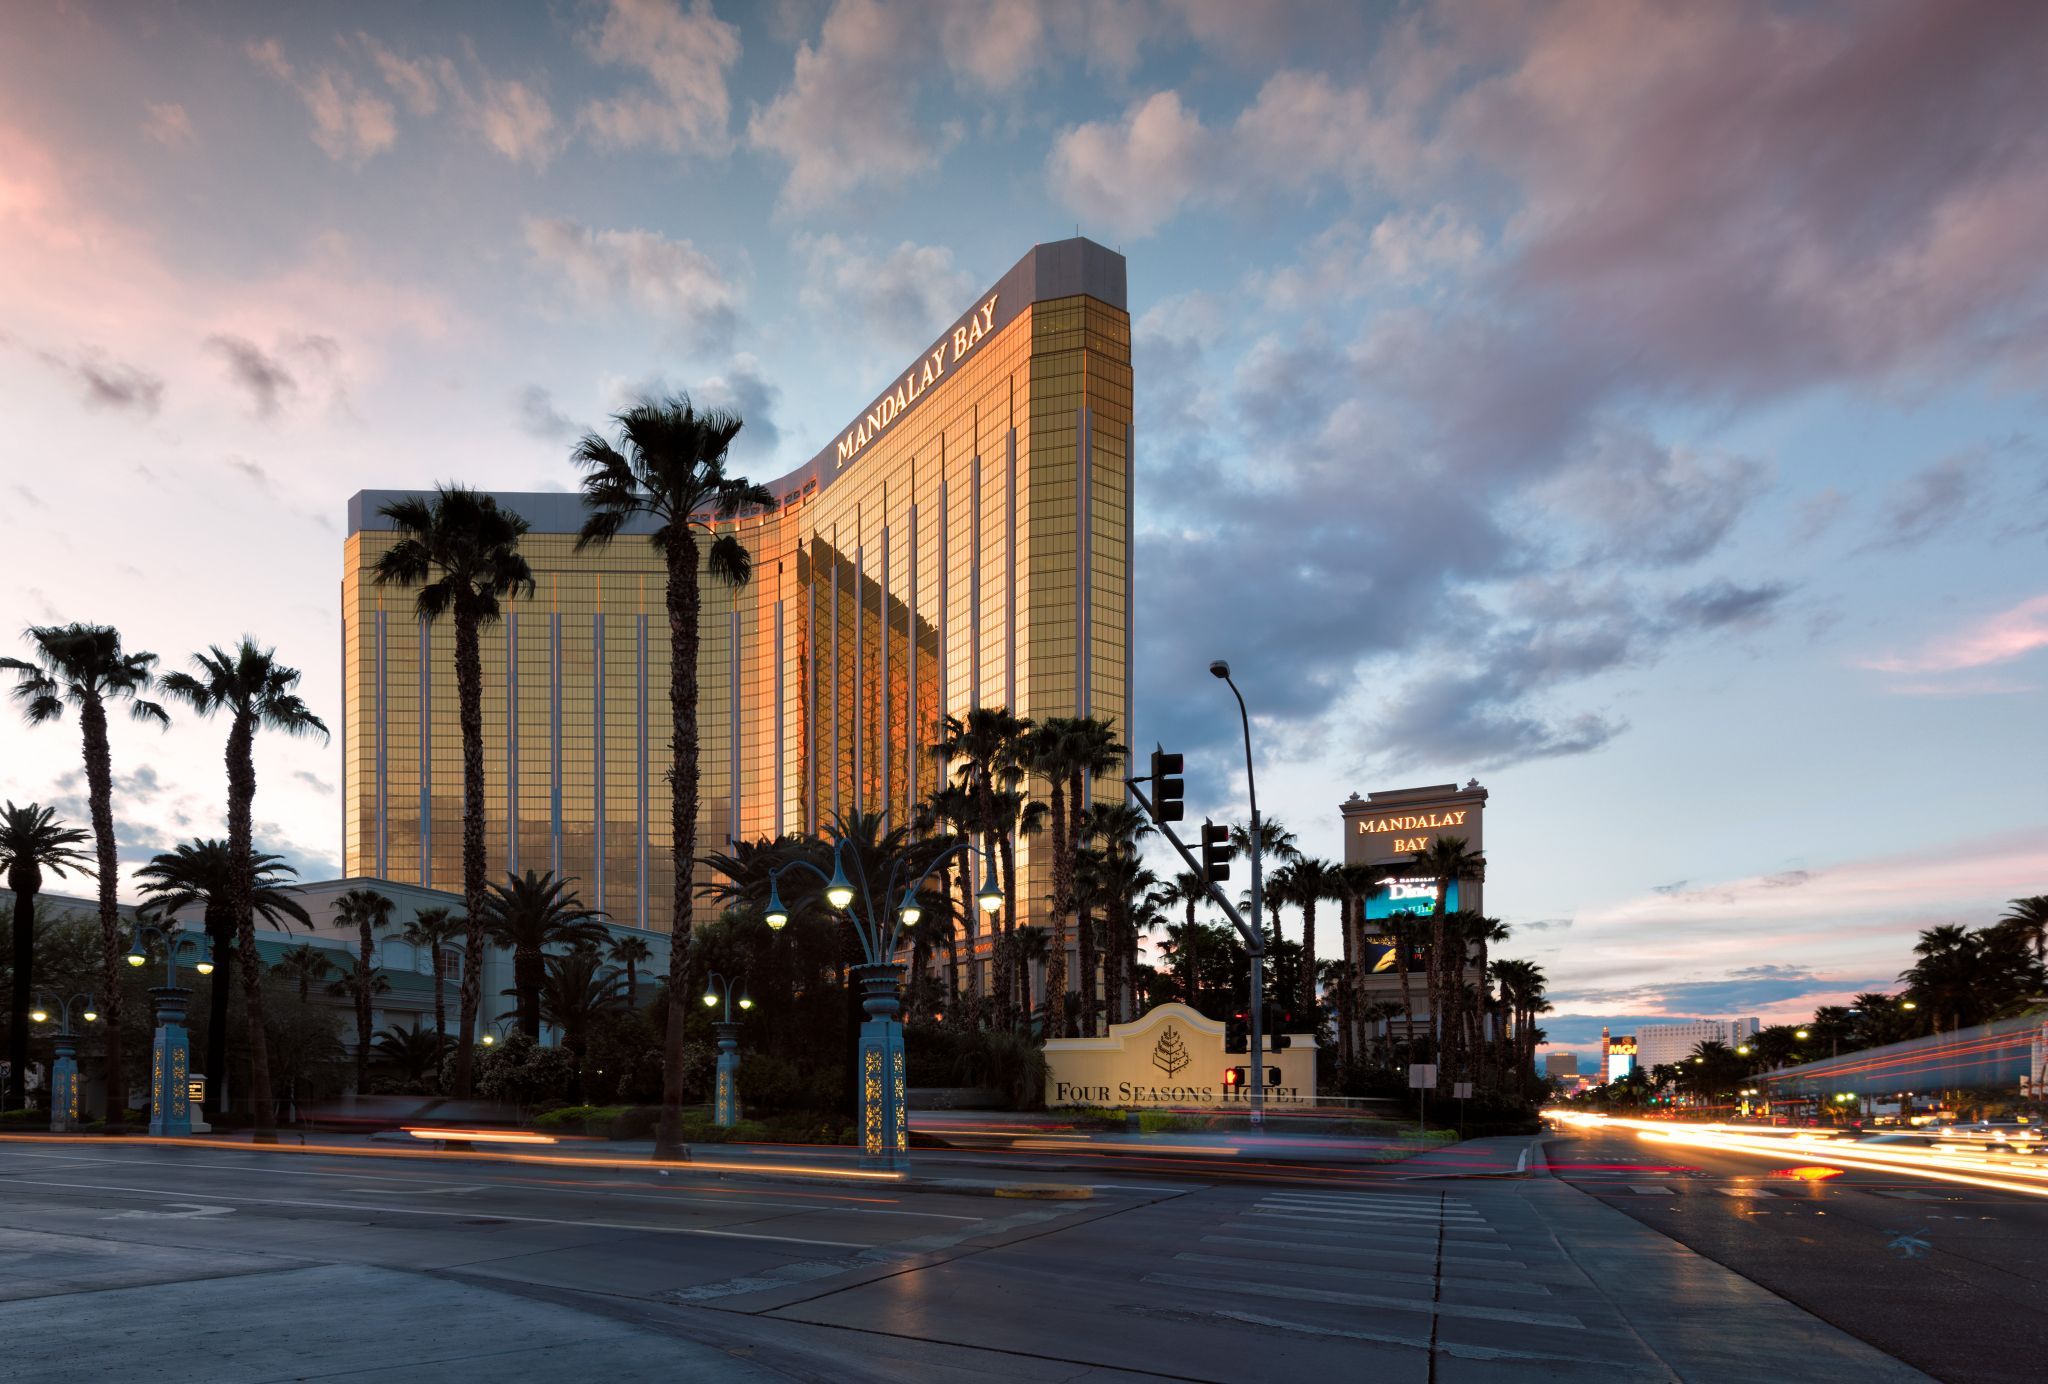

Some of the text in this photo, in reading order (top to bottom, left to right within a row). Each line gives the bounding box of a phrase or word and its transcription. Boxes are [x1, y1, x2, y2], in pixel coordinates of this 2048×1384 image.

[836, 294, 998, 469] MANDALAY BAY
[1358, 811, 1467, 834] MANDALAY
[1393, 837, 1429, 853] BAY
[1055, 1082, 1110, 1101] FOUR
[1118, 1081, 1213, 1103] SEASONS
